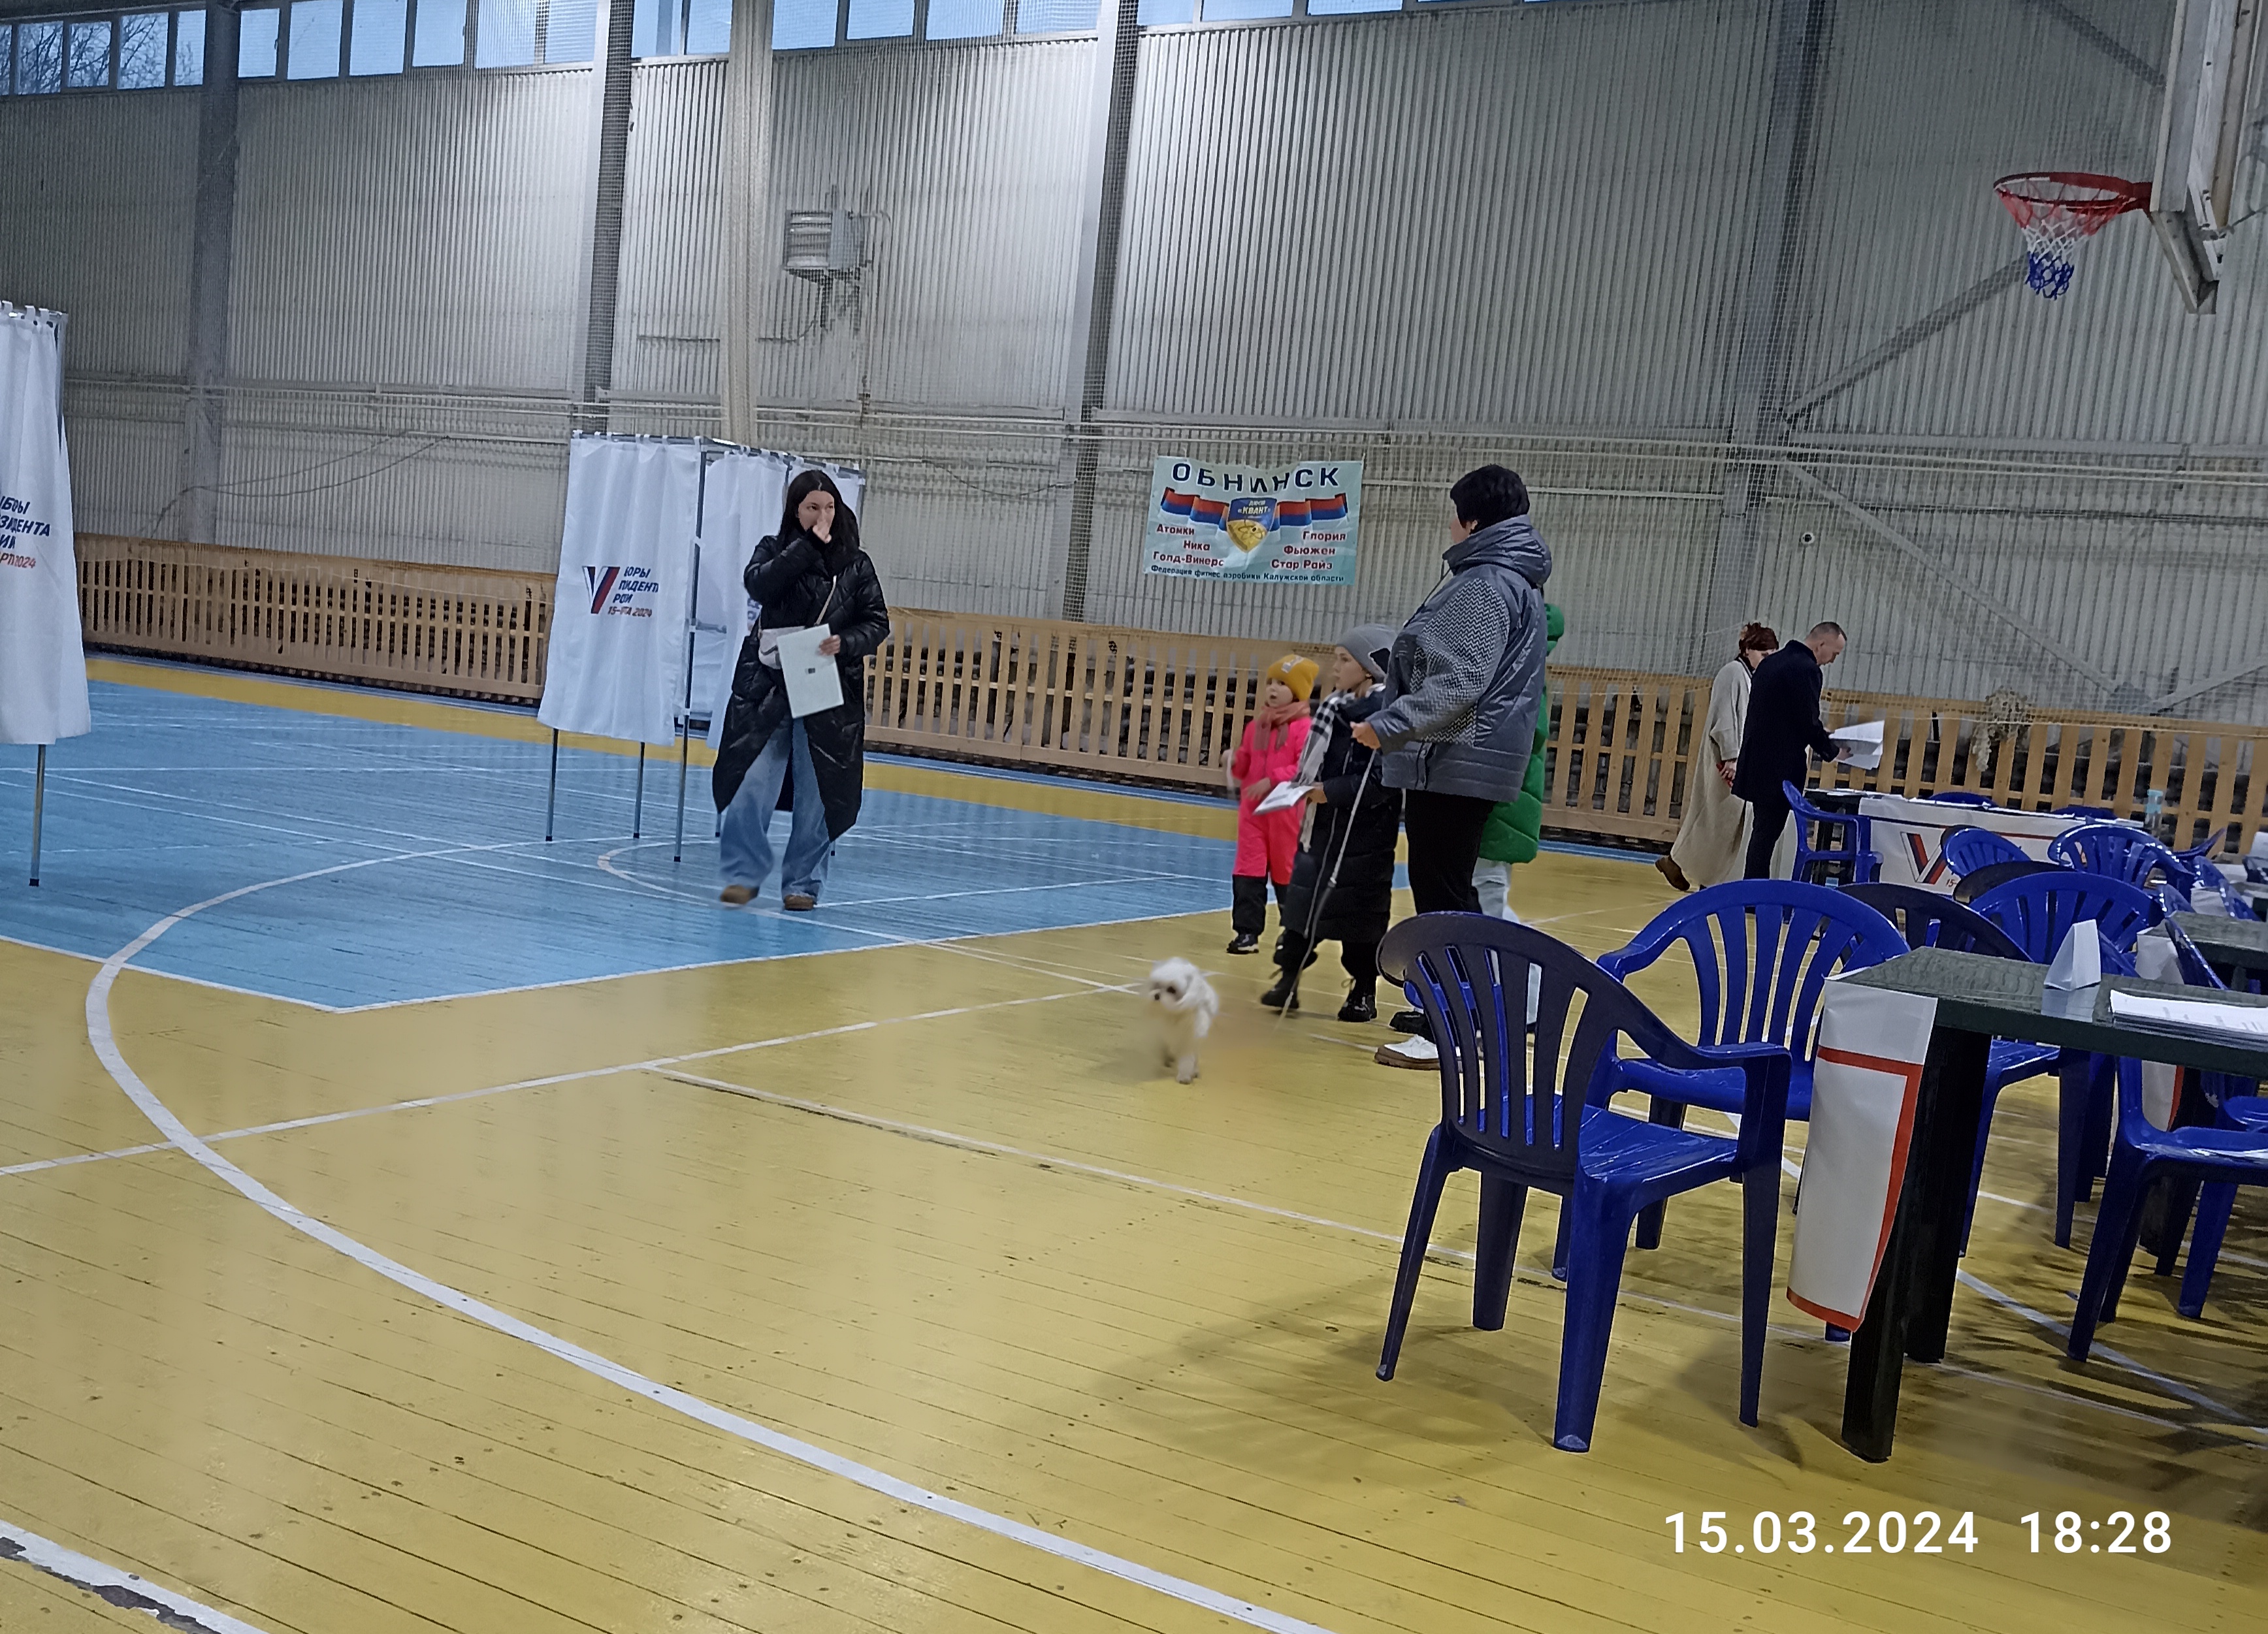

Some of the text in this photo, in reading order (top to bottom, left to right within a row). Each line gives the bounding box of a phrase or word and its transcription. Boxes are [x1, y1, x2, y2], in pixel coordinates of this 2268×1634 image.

[1173, 463, 1338, 493] ОБНИНСК
[1156, 524, 1195, 535] Атомки
[1303, 531, 1346, 541] Глория
[1183, 540, 1210, 551] Ника
[1284, 545, 1335, 554] Фьюжен
[1153, 551, 1225, 567] Голд-Винерс
[1271, 559, 1333, 570] Стар Райз
[1151, 565, 1192, 575] Федерация
[1194, 569, 1220, 577] фитнес
[1263, 573, 1308, 582] Калужской
[1310, 574, 1344, 583] области
